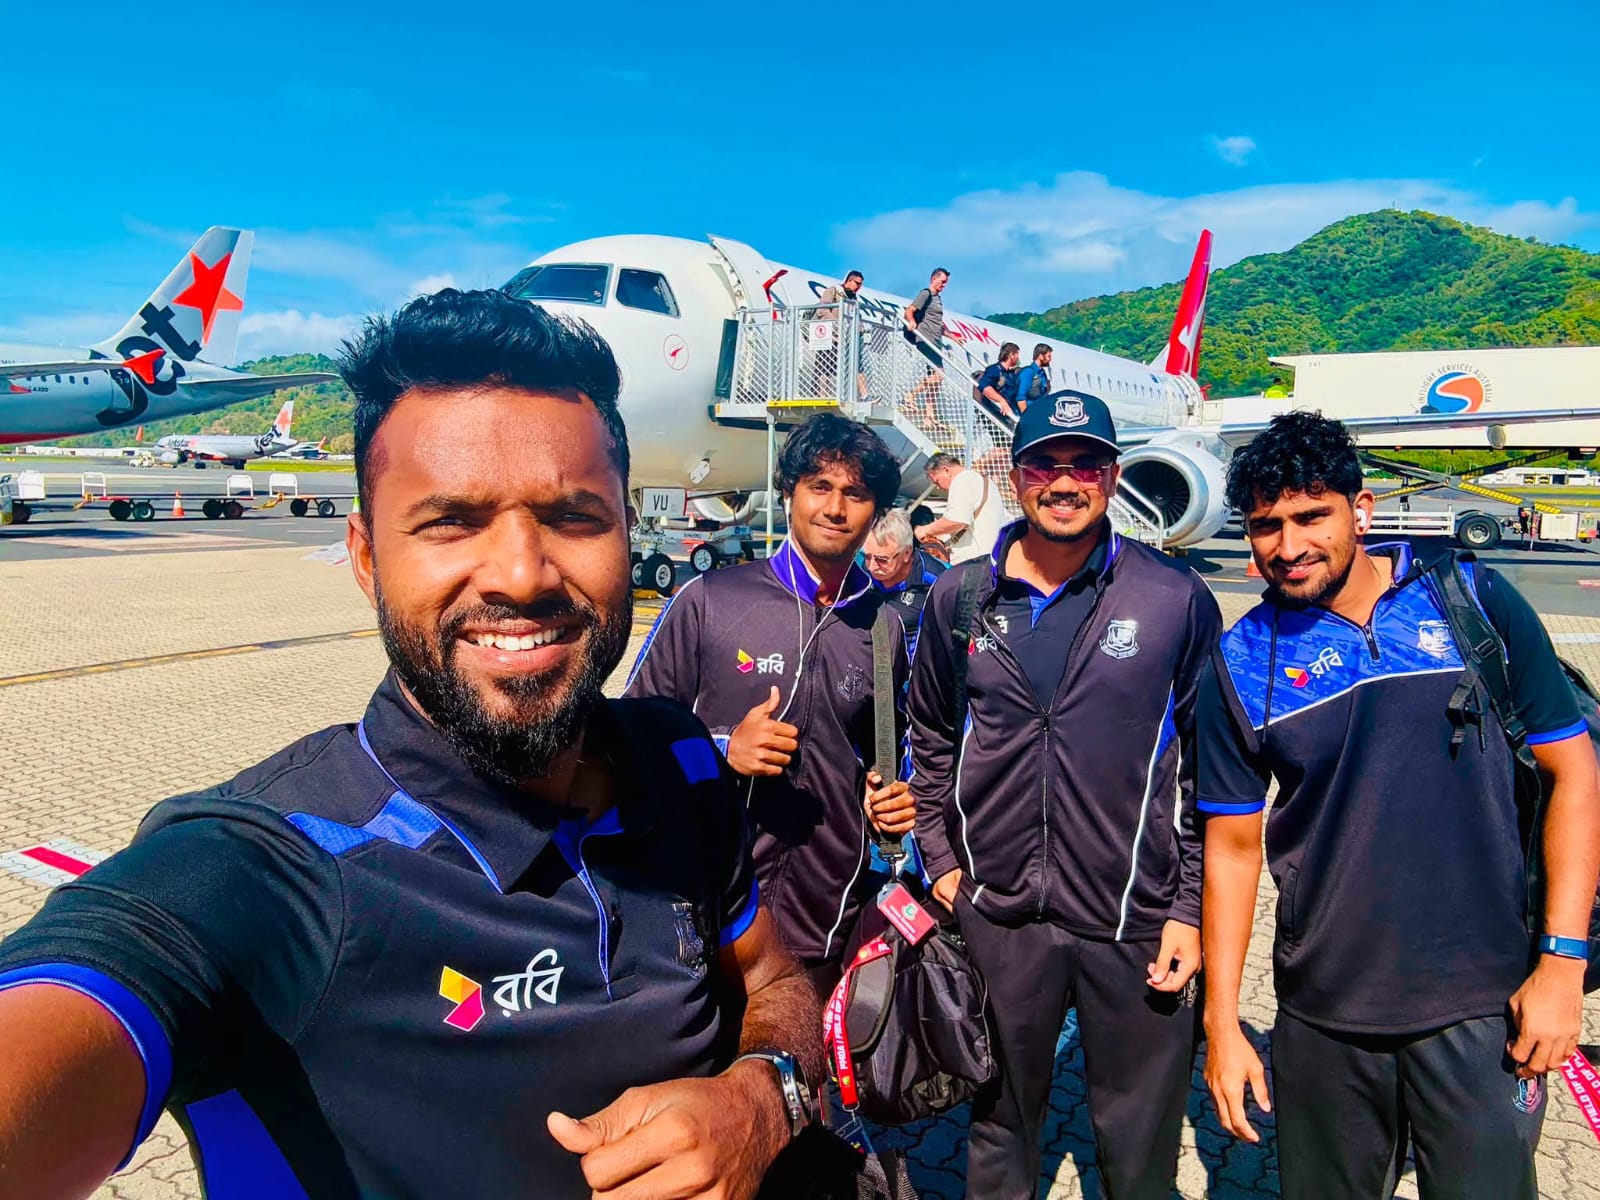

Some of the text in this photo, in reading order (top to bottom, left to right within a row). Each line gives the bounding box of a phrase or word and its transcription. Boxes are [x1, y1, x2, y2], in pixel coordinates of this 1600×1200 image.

[1437, 363, 1473, 374] SERVICES
[653, 494, 669, 511] VU
[756, 653, 785, 675] রবি
[1307, 646, 1345, 679] রবি
[491, 948, 565, 1018] রবি
